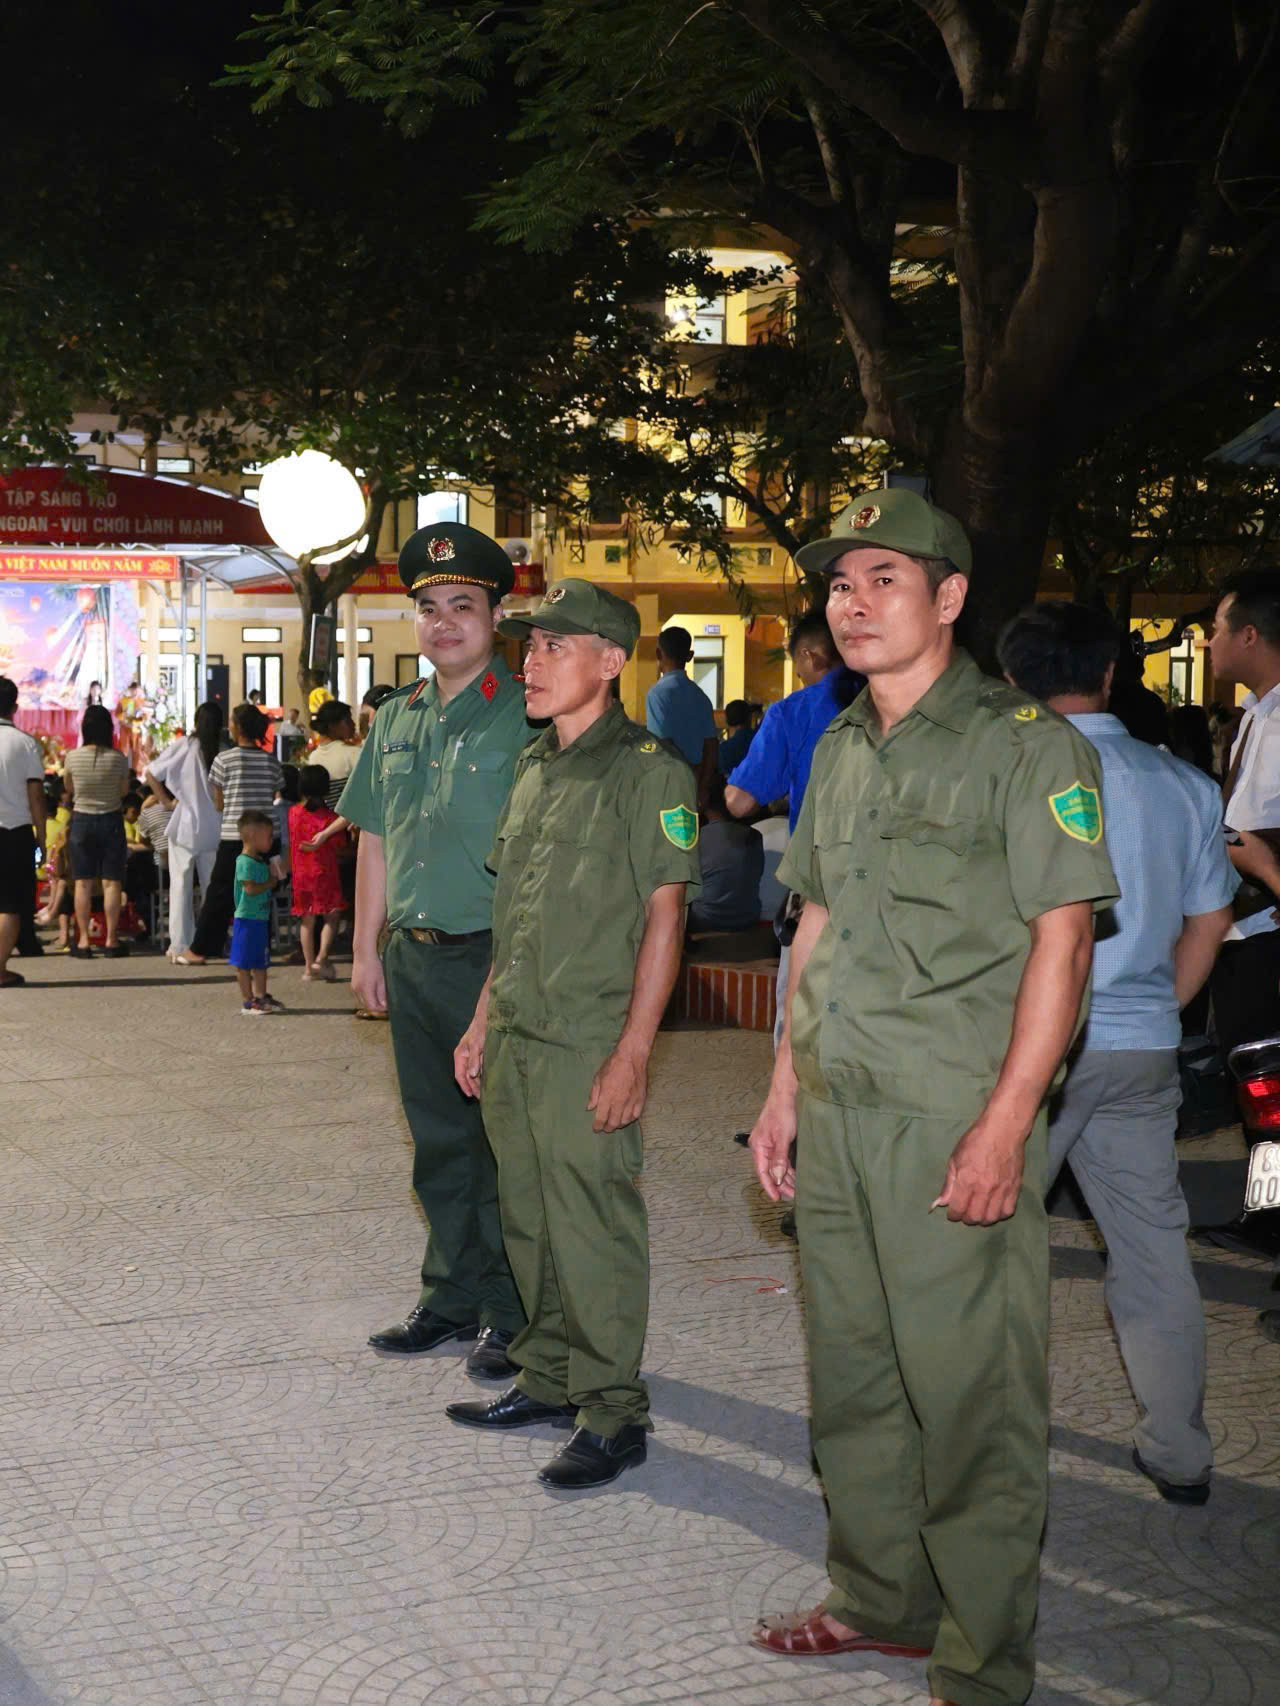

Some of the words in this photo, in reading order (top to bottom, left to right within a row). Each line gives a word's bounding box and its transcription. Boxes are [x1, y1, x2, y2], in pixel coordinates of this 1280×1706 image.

[5, 487, 36, 510] TẬP
[60, 517, 87, 533] VUI
[92, 516, 130, 534] CHƠI
[135, 514, 174, 535] LÀNH
[178, 519, 223, 538] MẠNH
[5, 556, 35, 573] VIỆT
[38, 557, 68, 570] NAM
[71, 556, 112, 571] MUÔN
[113, 556, 142, 571] NĂM
